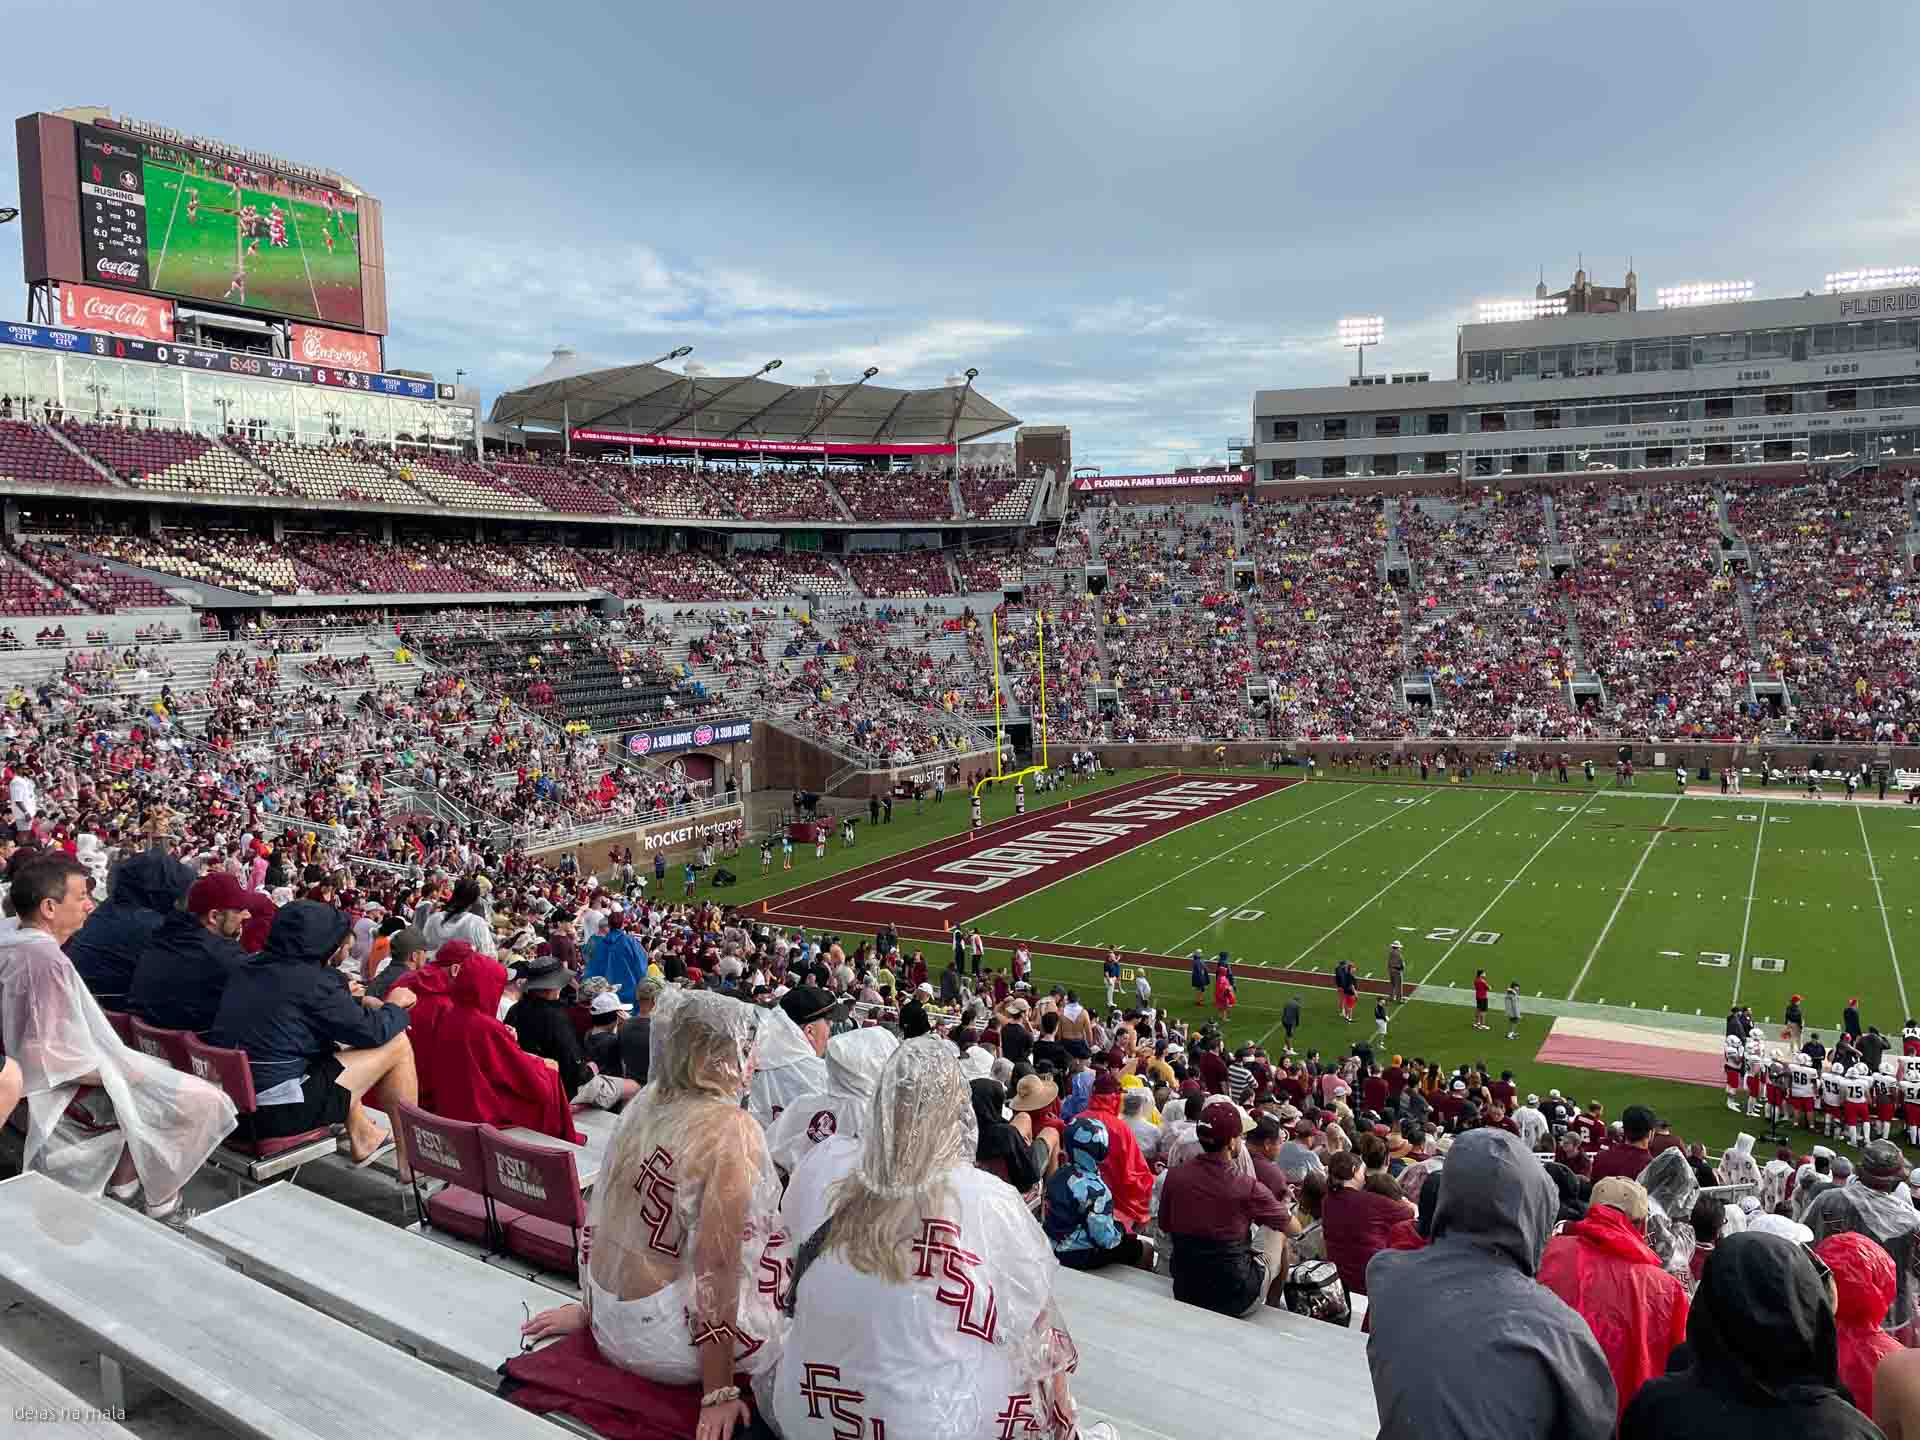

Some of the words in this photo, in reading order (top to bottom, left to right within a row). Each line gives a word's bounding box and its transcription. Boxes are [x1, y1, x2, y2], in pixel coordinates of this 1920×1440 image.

[120, 113, 184, 145] FLORIDA
[94, 186, 134, 201] RUSHING
[125, 208, 136, 217] 10
[93, 228, 108, 238] 6.0
[122, 234, 142, 245] 25.3
[127, 248, 138, 257] 14
[84, 296, 149, 327] Coca-Cola
[9, 326, 38, 336] OYSTER
[15, 332, 33, 342] CITY
[50, 331, 77, 341] OYSTER
[55, 337, 73, 347] CITY
[96, 343, 104, 353] 3
[157, 347, 168, 361] 0
[177, 354, 185, 364] 2
[205, 358, 212, 367] 7
[229, 356, 261, 373] 6:49
[271, 368, 283, 377] 27
[317, 370, 327, 382] 6
[1094, 480, 1130, 488] FLORIDA
[1132, 478, 1154, 487] FARM
[1156, 476, 1189, 486] BUREAU
[1190, 474, 1243, 485] FEDERATION
[715, 728, 720, 739] A
[720, 726, 732, 738] SUB
[733, 724, 751, 736] ABOVE
[653, 740, 659, 748] A
[659, 737, 672, 748] SUB
[672, 732, 692, 745] ABOVE
[645, 827, 694, 850] ROCKET
[695, 819, 742, 837] Mortgage
[851, 822, 1148, 911] FLORIDA
[1099, 781, 1259, 820] STATE
[1425, 927, 1503, 945] 20
[1697, 952, 1787, 973] 30
[1847, 1086, 1863, 1099] 75
[414, 1126, 441, 1152] FSU
[1580, 1126, 1591, 1143] 2
[495, 1151, 528, 1180] FSU
[912, 1218, 998, 1344] FSU
